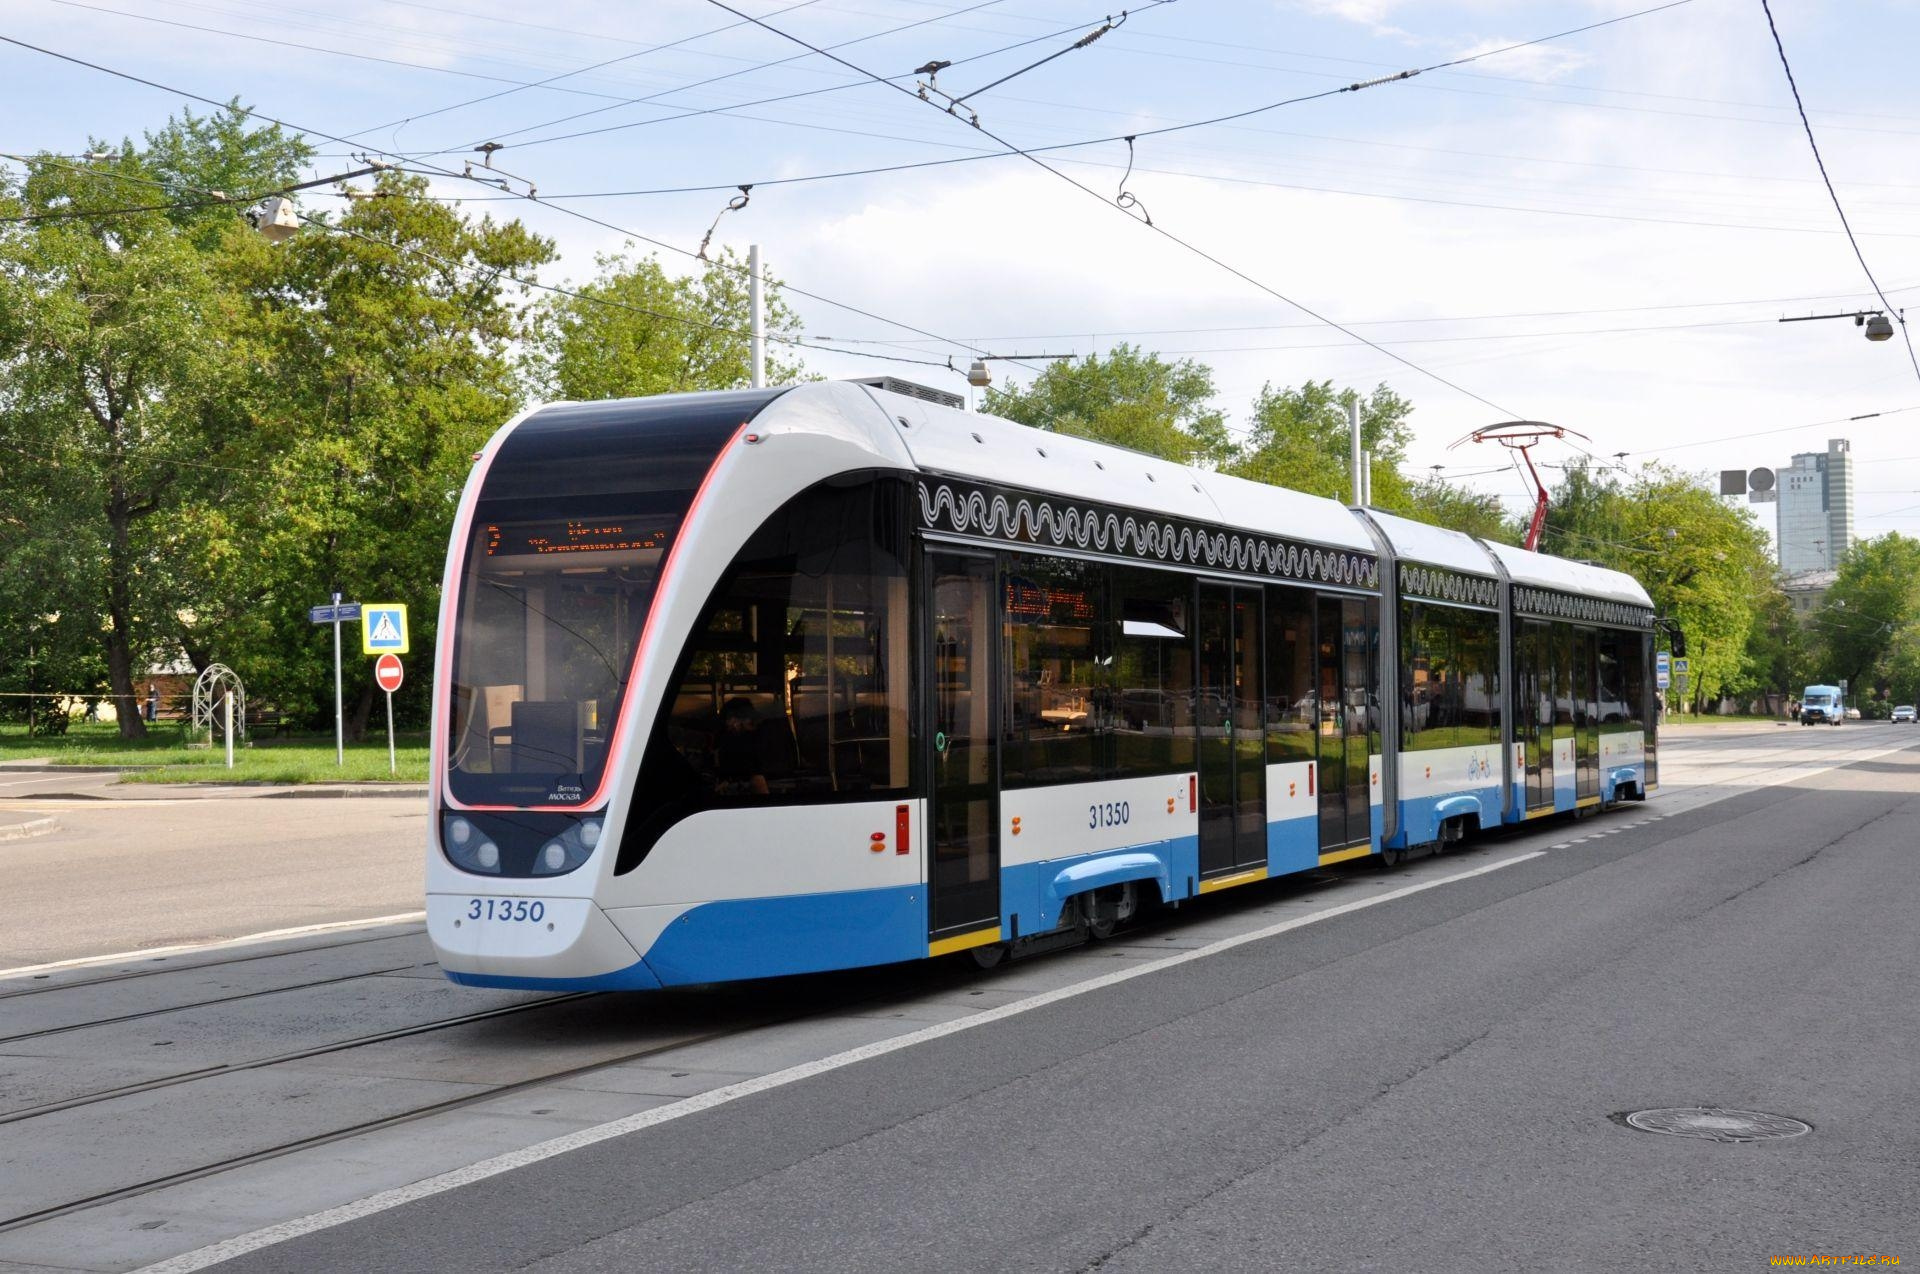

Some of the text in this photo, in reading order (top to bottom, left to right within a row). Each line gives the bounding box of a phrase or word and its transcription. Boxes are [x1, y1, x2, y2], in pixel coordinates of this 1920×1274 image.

[549, 793, 581, 801] МОСКВА
[1090, 801, 1130, 829] 31350
[468, 899, 545, 922] 31350
